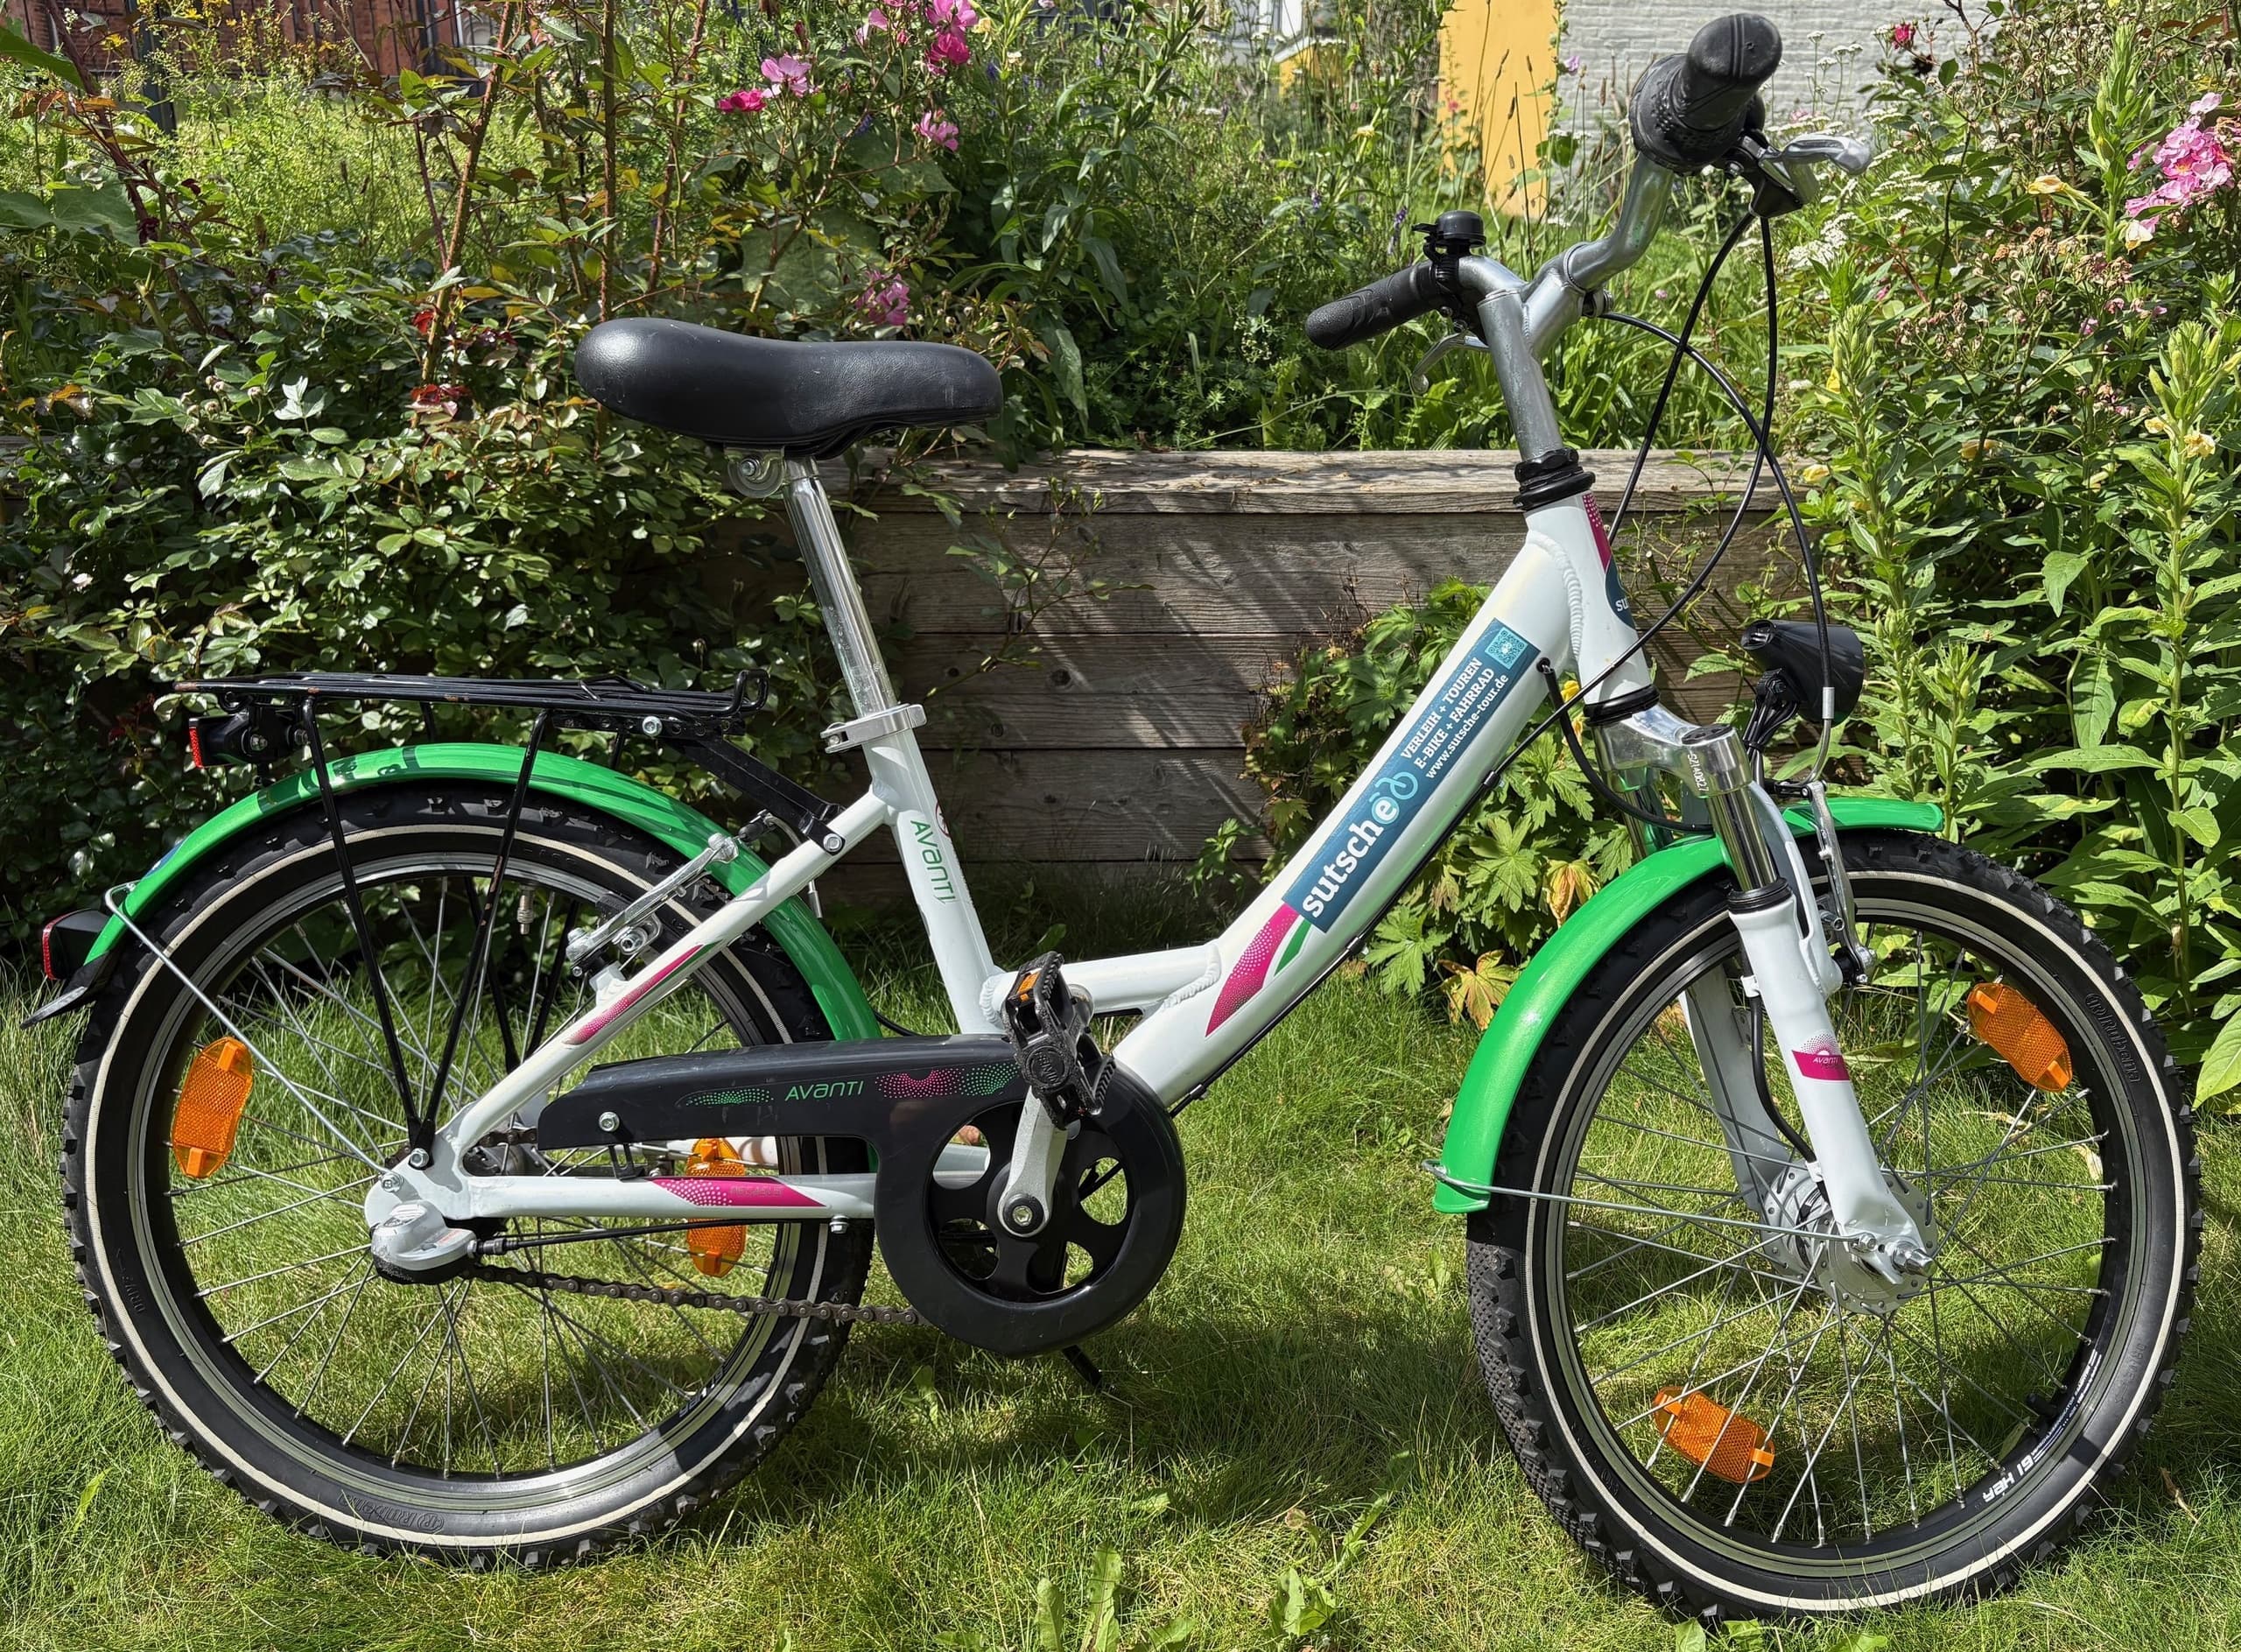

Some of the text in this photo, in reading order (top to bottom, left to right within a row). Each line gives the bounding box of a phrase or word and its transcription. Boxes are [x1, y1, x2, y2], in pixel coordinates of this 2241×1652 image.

[1401, 657, 1483, 759] VERLEIH + TOUREN
[1414, 668, 1495, 770] E-BIKE + FAHRRAD
[1425, 674, 1509, 779] www.sutsche-tour.de
[1302, 798, 1398, 918] sutsche
